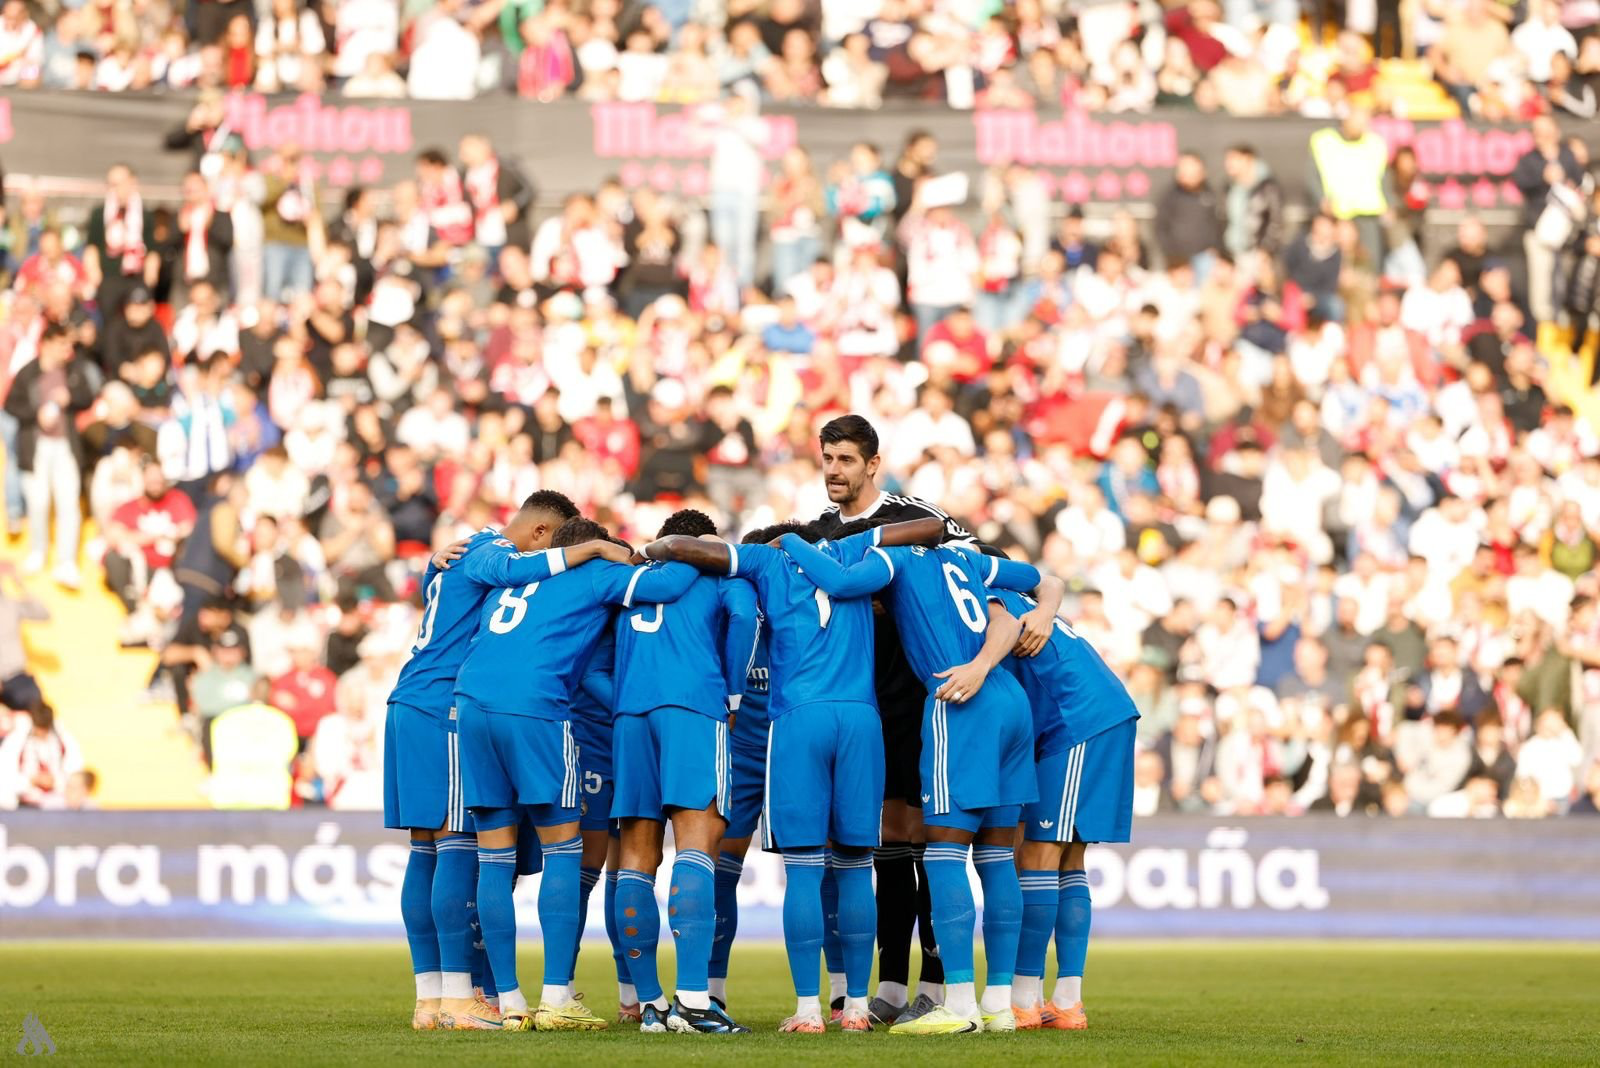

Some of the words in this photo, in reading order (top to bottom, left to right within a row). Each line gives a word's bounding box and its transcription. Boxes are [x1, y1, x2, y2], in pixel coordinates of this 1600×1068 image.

[592, 101, 797, 161] Mau
[974, 109, 1178, 168] Mahou
[942, 562, 987, 633] 6
[197, 822, 411, 908] más
